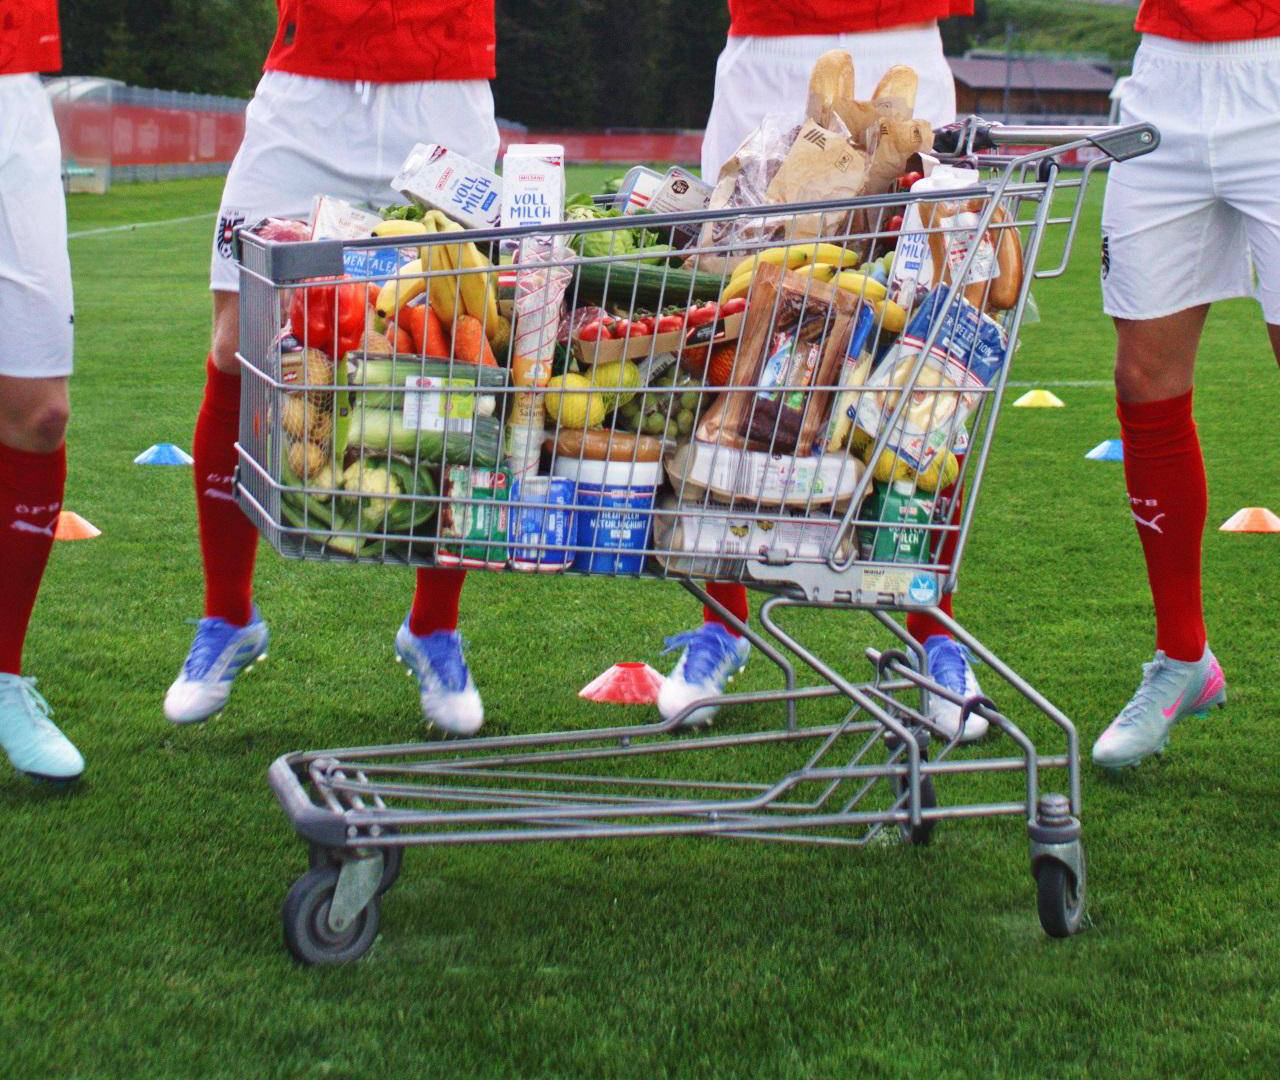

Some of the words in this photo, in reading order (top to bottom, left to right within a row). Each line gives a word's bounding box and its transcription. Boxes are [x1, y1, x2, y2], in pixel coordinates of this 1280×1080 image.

[452, 176, 478, 204] VOLL
[461, 176, 492, 214] MILCH
[514, 193, 547, 206] VOLL
[510, 206, 551, 219] MILCH
[907, 233, 927, 244] VOL
